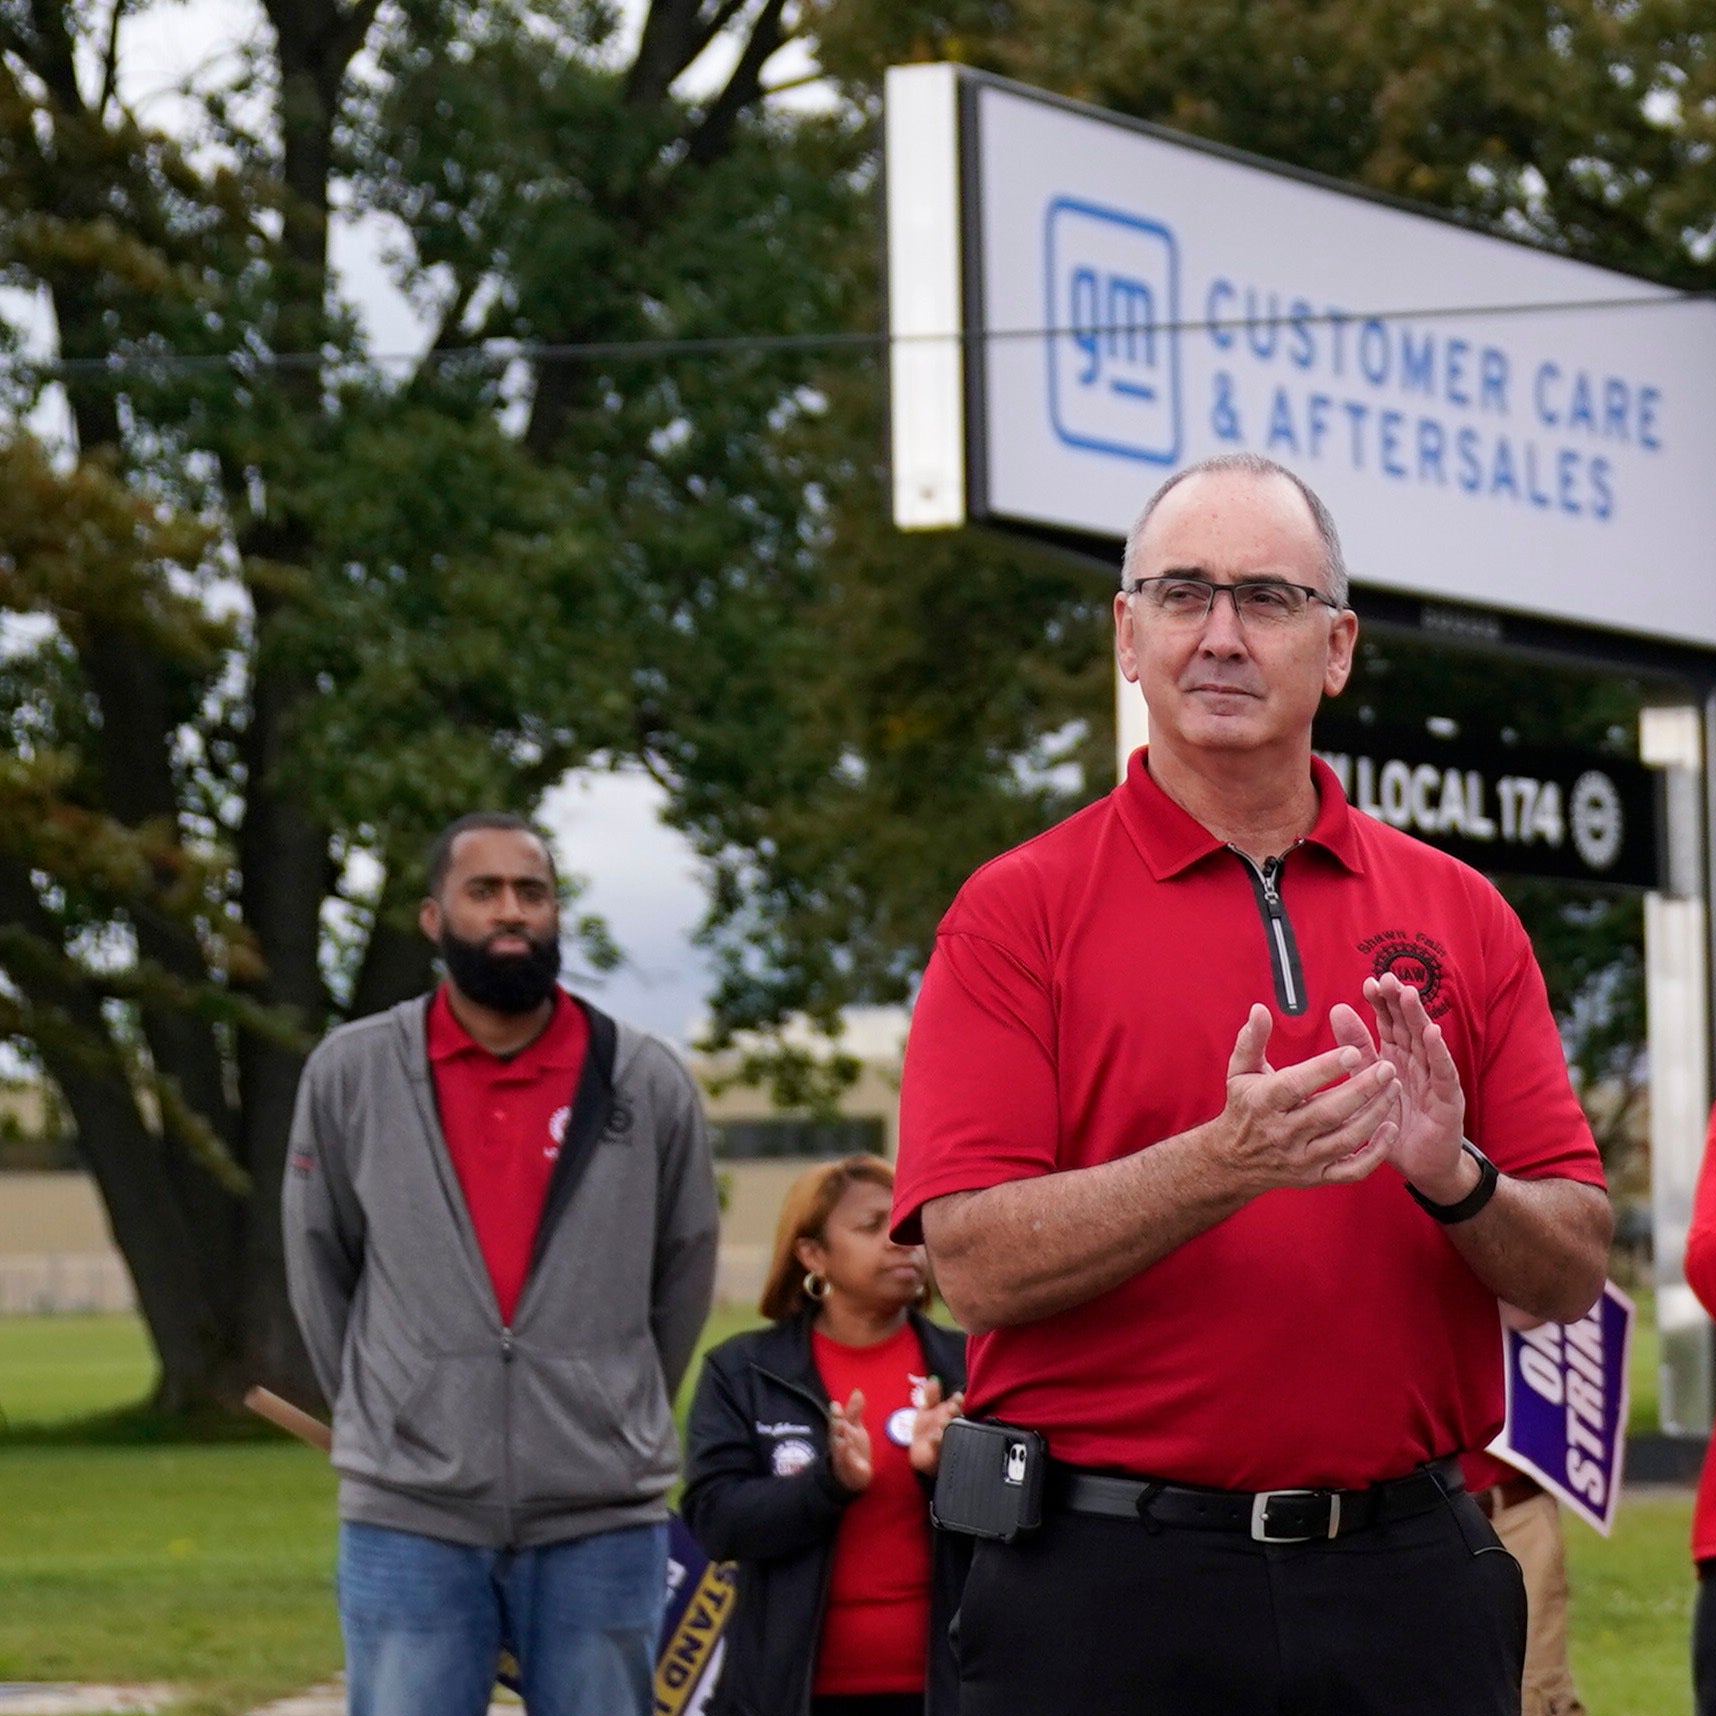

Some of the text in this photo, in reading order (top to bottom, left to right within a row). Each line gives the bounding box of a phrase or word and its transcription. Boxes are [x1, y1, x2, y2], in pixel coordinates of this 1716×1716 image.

[1070, 265, 1156, 387] gm
[1207, 277, 1664, 451] CUSTOMER CARE
[1211, 369, 1614, 521] & AFTERSALES
[1356, 754, 1497, 839] LOCAL
[1495, 774, 1563, 848] 174
[1564, 1299, 1606, 1507] STRIK
[663, 1560, 739, 1689] STAND
